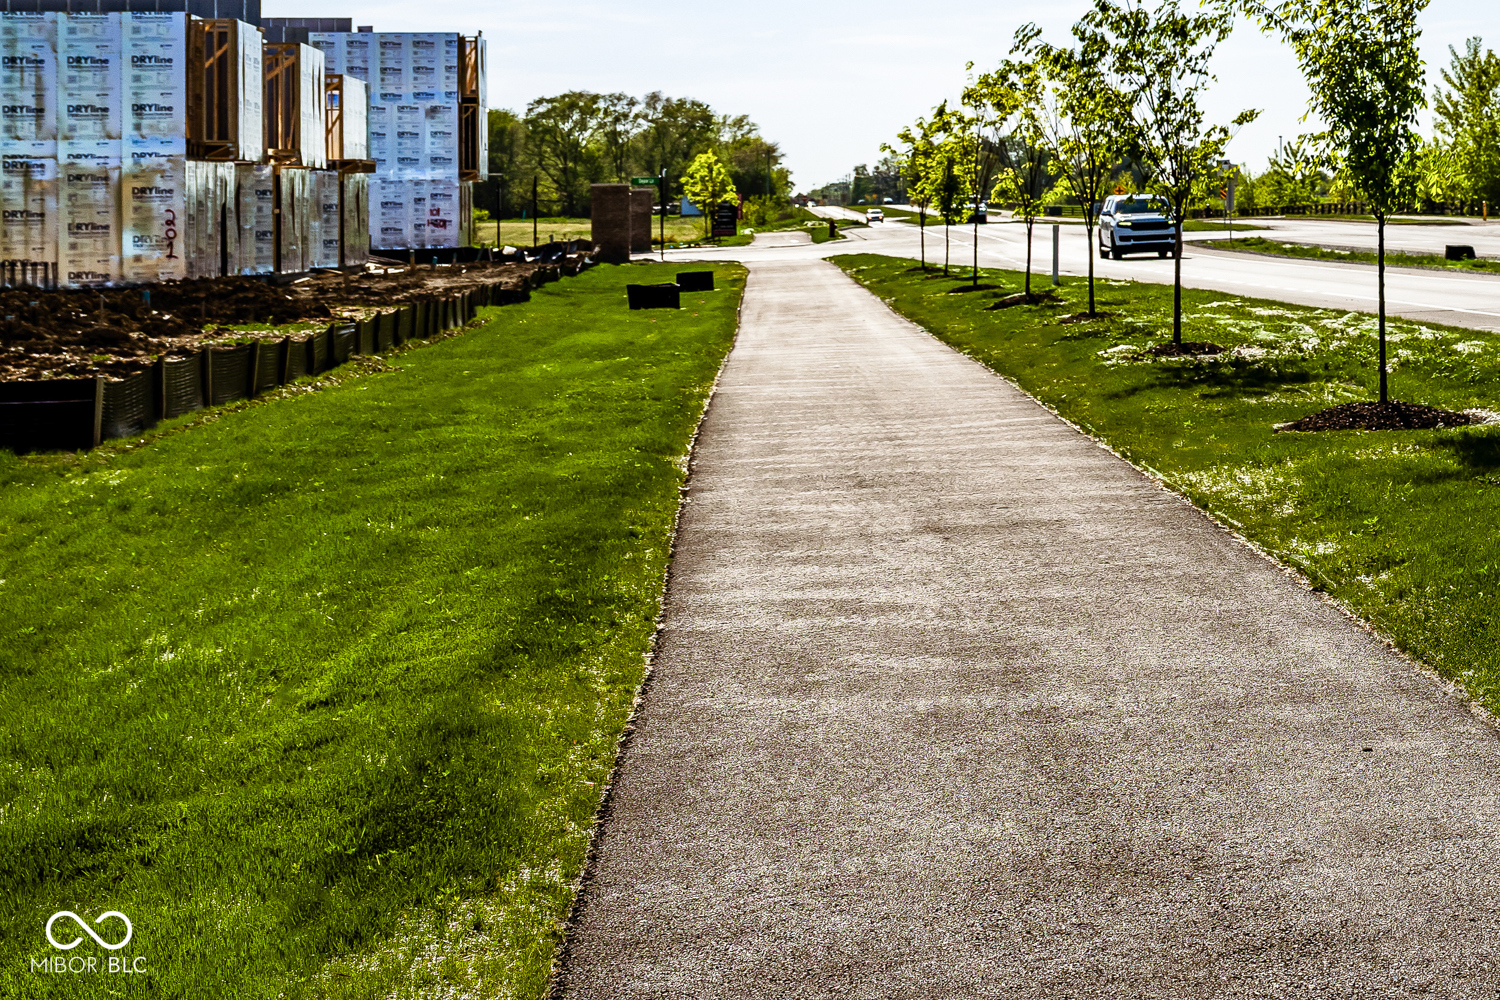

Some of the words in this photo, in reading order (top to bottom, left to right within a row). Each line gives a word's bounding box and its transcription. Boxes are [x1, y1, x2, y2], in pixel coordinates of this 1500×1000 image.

[67, 56, 110, 64] DRYline
[131, 56, 173, 64] DRYline
[67, 104, 110, 113] DRYline
[132, 104, 174, 112] DRYline
[132, 186, 174, 194] DRYline
